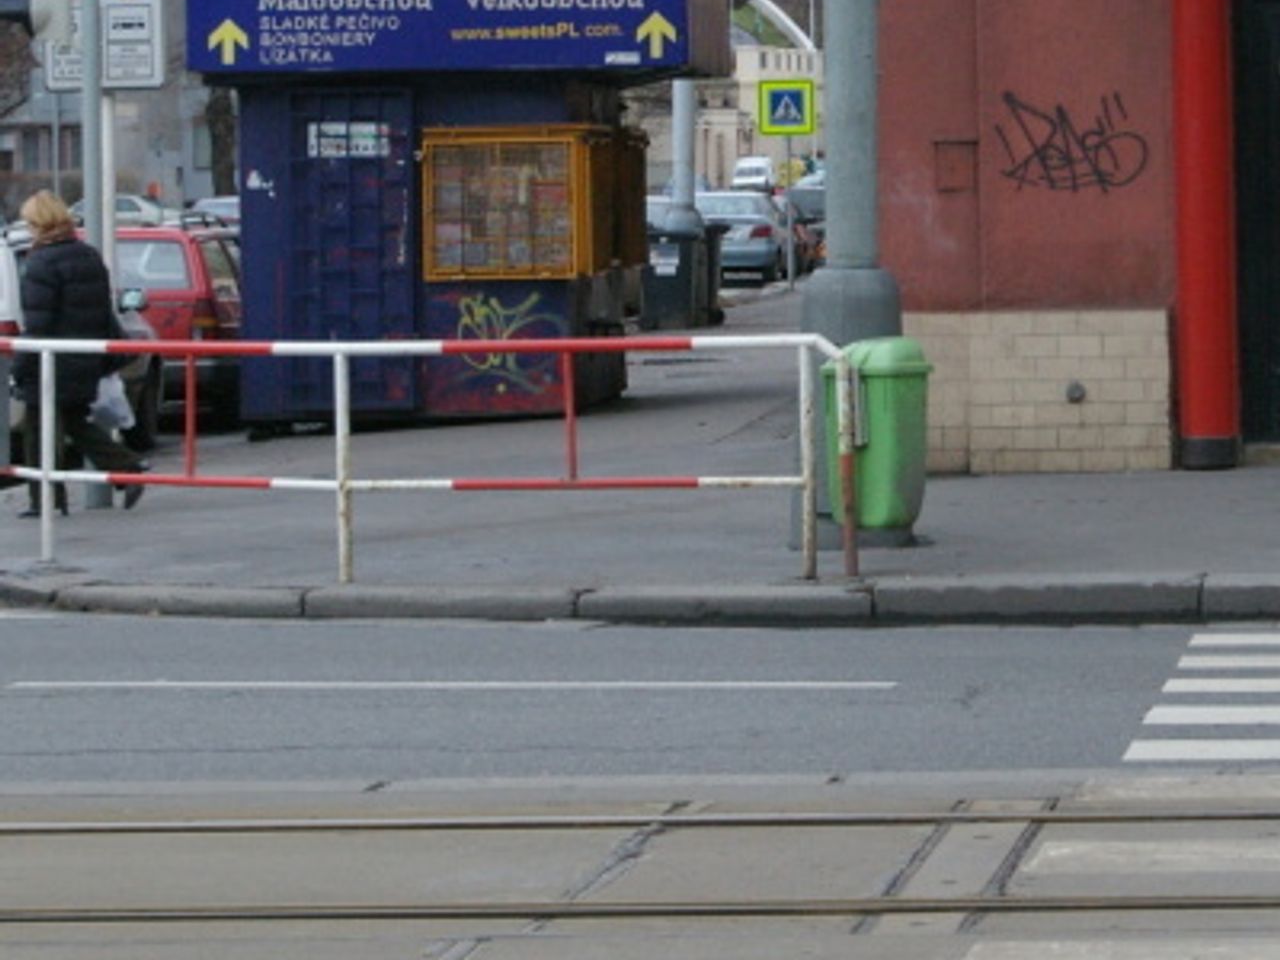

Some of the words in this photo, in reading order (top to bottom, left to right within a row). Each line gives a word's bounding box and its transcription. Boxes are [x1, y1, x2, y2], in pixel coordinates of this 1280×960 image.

[259, 12, 331, 31] SLADKÉ
[335, 12, 401, 31] PEČIVO
[258, 31, 377, 47] BONBONIERY
